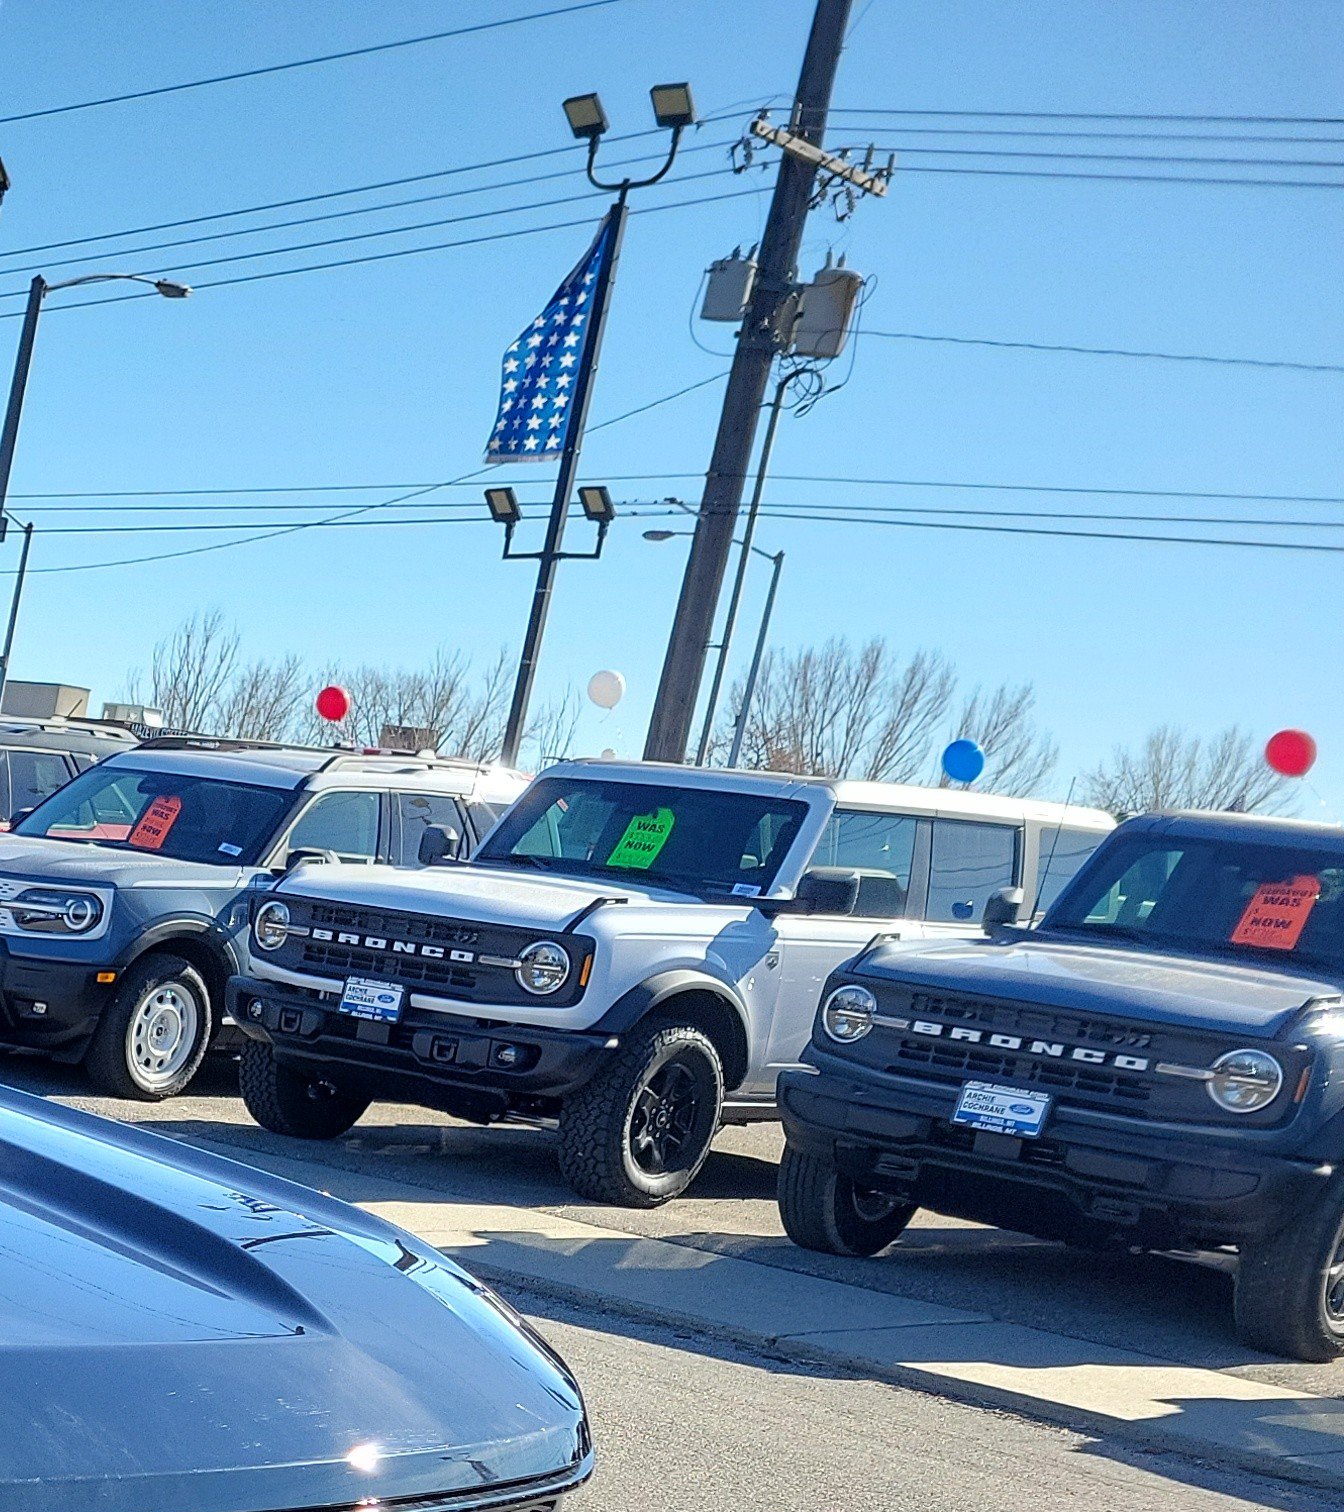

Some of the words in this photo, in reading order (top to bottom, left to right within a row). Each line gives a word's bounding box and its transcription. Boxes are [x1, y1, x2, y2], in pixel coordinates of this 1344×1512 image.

[637, 820, 666, 834] WAS
[624, 839, 656, 853] NOW
[1262, 896, 1302, 907] WAS
[1250, 916, 1293, 930] NOW
[312, 927, 475, 963] BRONCO
[912, 1019, 1149, 1072] BRONCO
[962, 1101, 1006, 1115] COCHRANE
